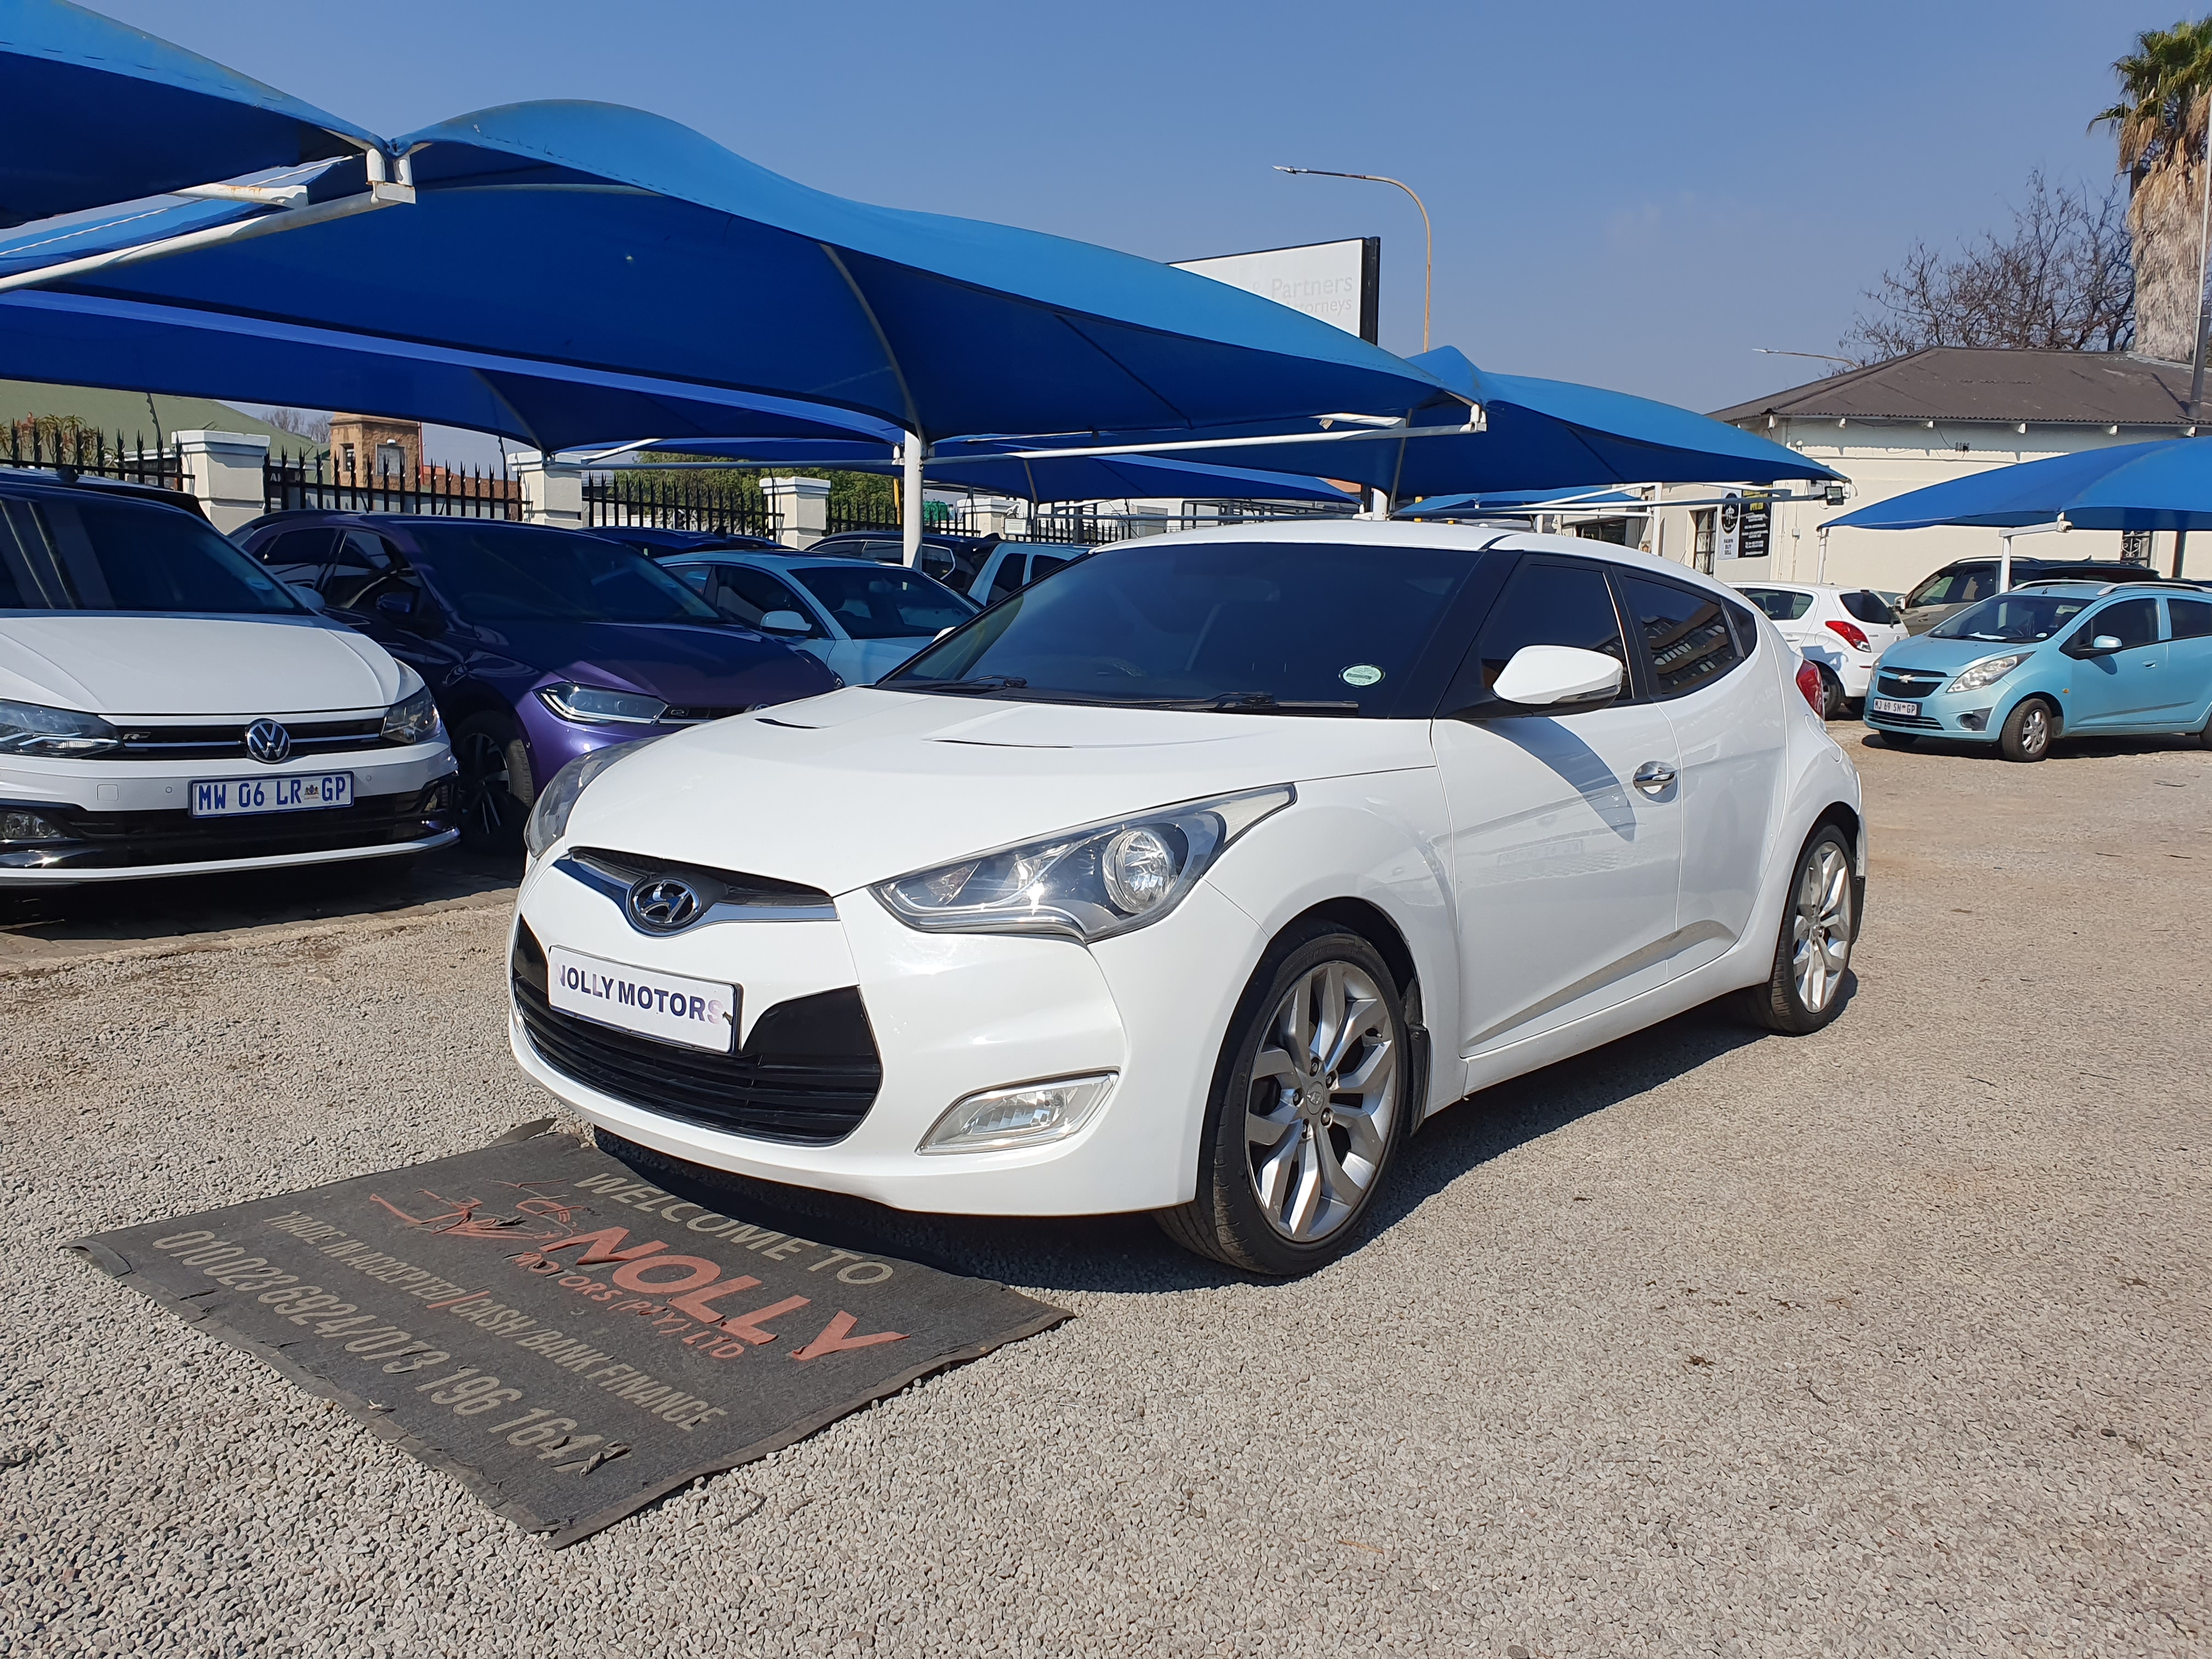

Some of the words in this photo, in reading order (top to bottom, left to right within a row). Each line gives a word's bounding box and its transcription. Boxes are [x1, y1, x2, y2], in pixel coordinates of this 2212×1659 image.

[1271, 276, 1353, 300] Partners
[1875, 700, 1882, 709] MJ
[1883, 702, 1891, 710] 69
[1893, 703, 1901, 712] SN
[1906, 704, 1915, 714] GP
[199, 784, 226, 810] MW
[238, 782, 264, 808] 06
[276, 779, 302, 805] LR
[321, 776, 346, 802] GP
[555, 962, 614, 1000] NOLLY
[618, 980, 724, 1025] MOTORS
[574, 1172, 816, 1261] WELCOME
[807, 1248, 895, 1285] TO
[263, 1211, 348, 1245] TRADE
[319, 1239, 370, 1257] IN
[584, 1362, 729, 1432] FINANCE
[503, 1251, 623, 1301] MOTORS
[682, 1330, 746, 1359] LTD
[539, 1226, 910, 1361] NOLLY
[415, 1365, 522, 1416] 196
